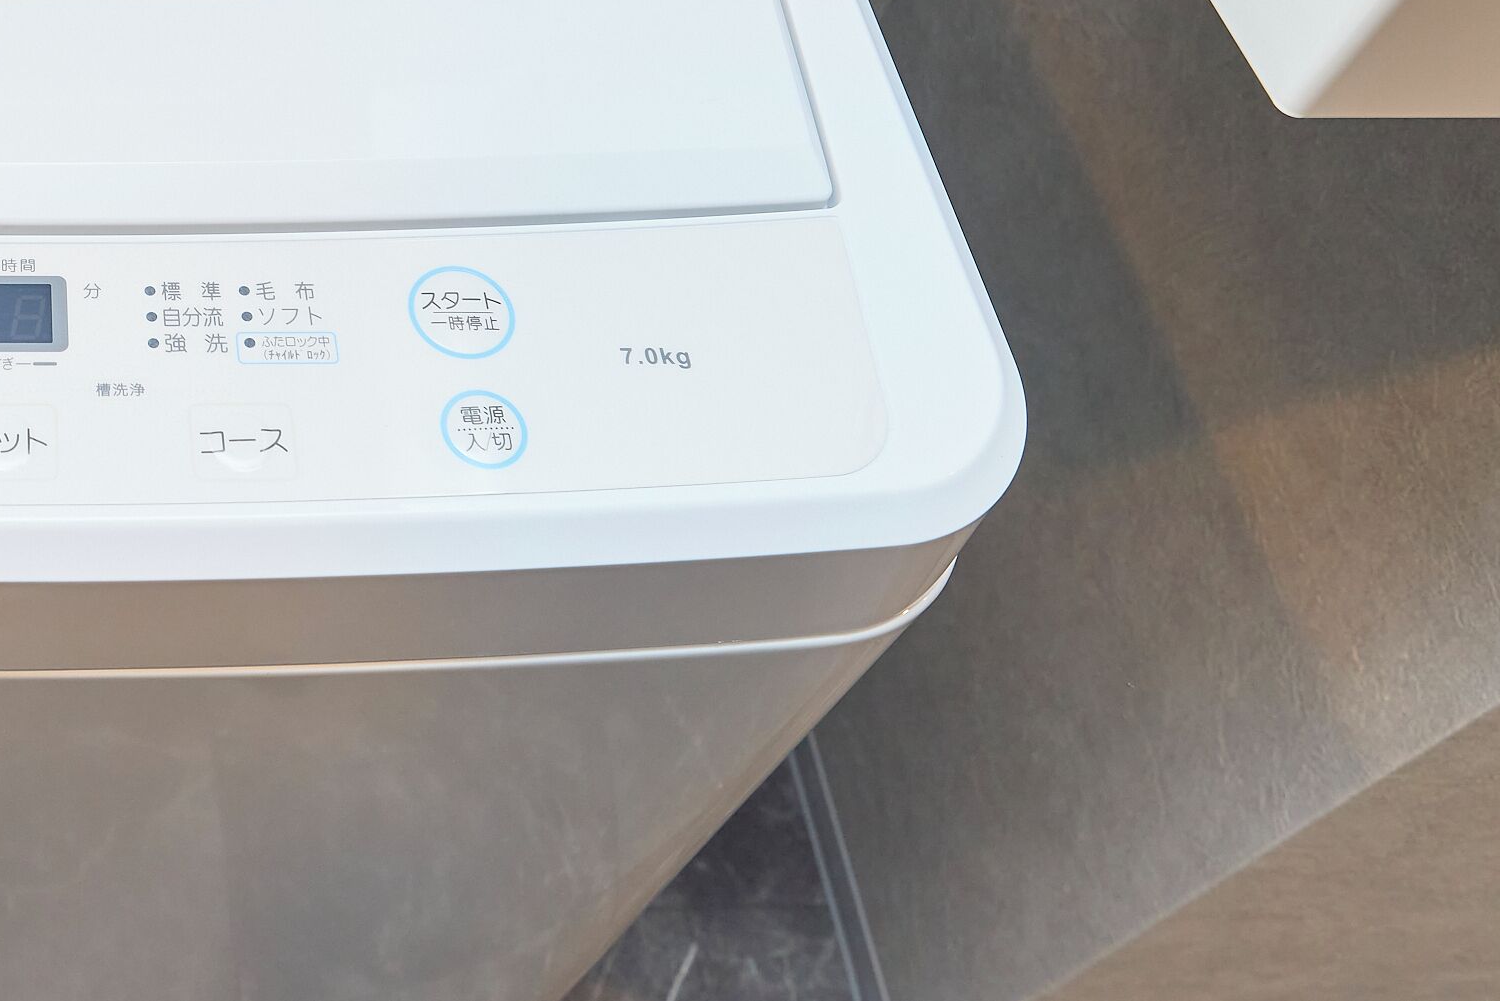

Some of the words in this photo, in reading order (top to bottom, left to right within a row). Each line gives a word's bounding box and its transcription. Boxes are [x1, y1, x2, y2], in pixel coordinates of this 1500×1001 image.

[83, 282, 102, 299] 分
[161, 281, 222, 301] 標準
[255, 281, 315, 301] 毛布
[420, 291, 502, 310] スタート
[163, 307, 224, 327] 自分流
[258, 306, 322, 326] ソフト
[430, 315, 500, 331] 一時停止
[164, 333, 229, 353] 強洗
[262, 336, 330, 347] ふたロック中
[619, 347, 692, 369] 7.0kg
[95, 383, 145, 397] 槽洗浄
[459, 405, 507, 425] 電源
[199, 428, 288, 453] コース
